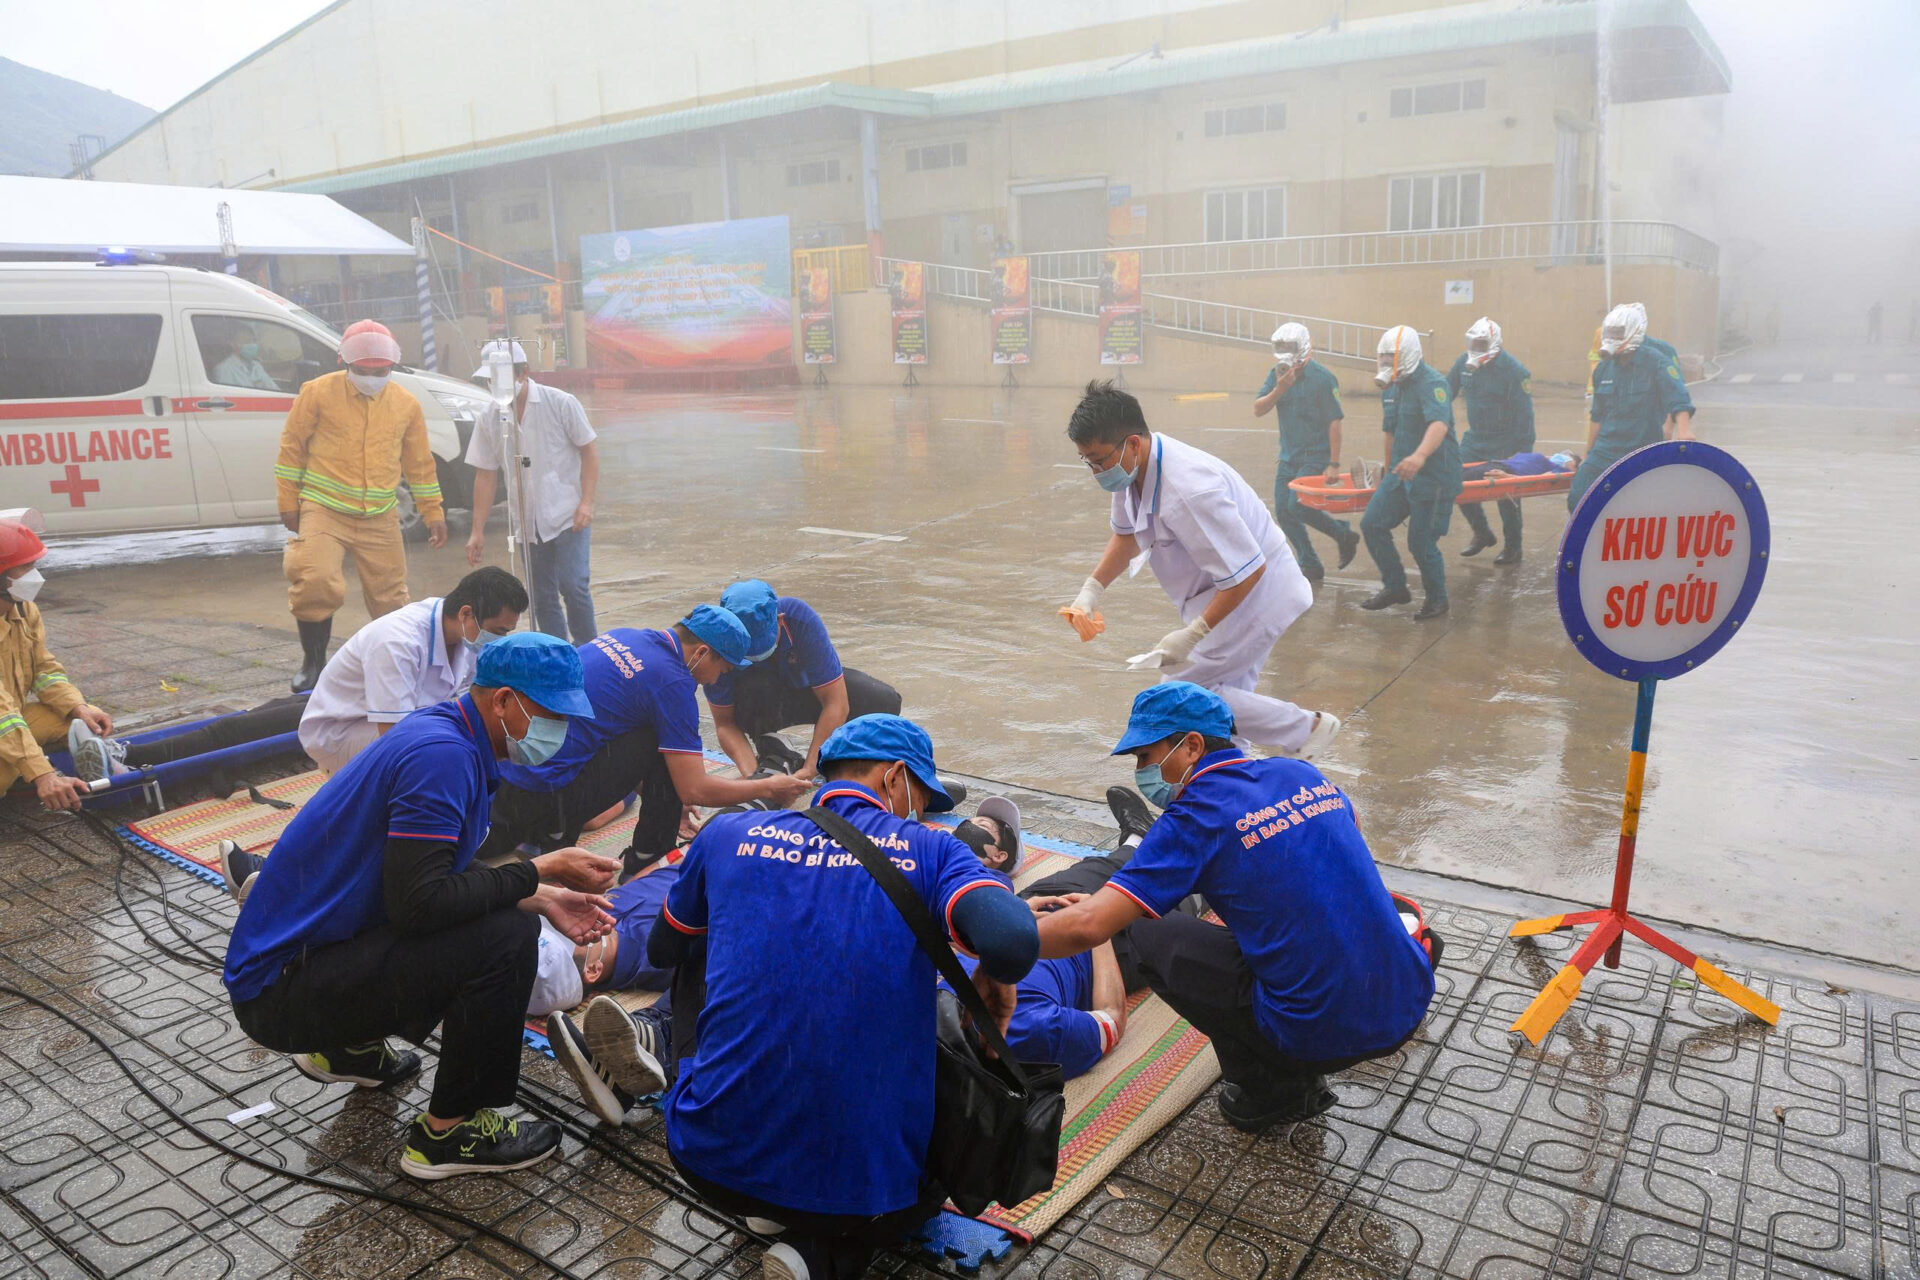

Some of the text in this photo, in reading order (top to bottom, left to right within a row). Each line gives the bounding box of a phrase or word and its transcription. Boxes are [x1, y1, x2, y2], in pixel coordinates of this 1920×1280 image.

[0, 428, 173, 466] MBULANCE
[1601, 510, 1736, 568] KHU VỰC
[1603, 573, 1718, 629] SƠ CỨU
[1236, 806, 1278, 832] CÔNG
[1275, 799, 1294, 813] TY
[1292, 786, 1315, 805] CỔ
[1241, 831, 1260, 850] IN
[1259, 818, 1290, 839] BAO
[1288, 809, 1305, 825] BÌ
[736, 843, 757, 856] IN
[760, 844, 802, 864] BAO
[805, 851, 824, 867] BÌ
[747, 825, 804, 845] CÔNG
